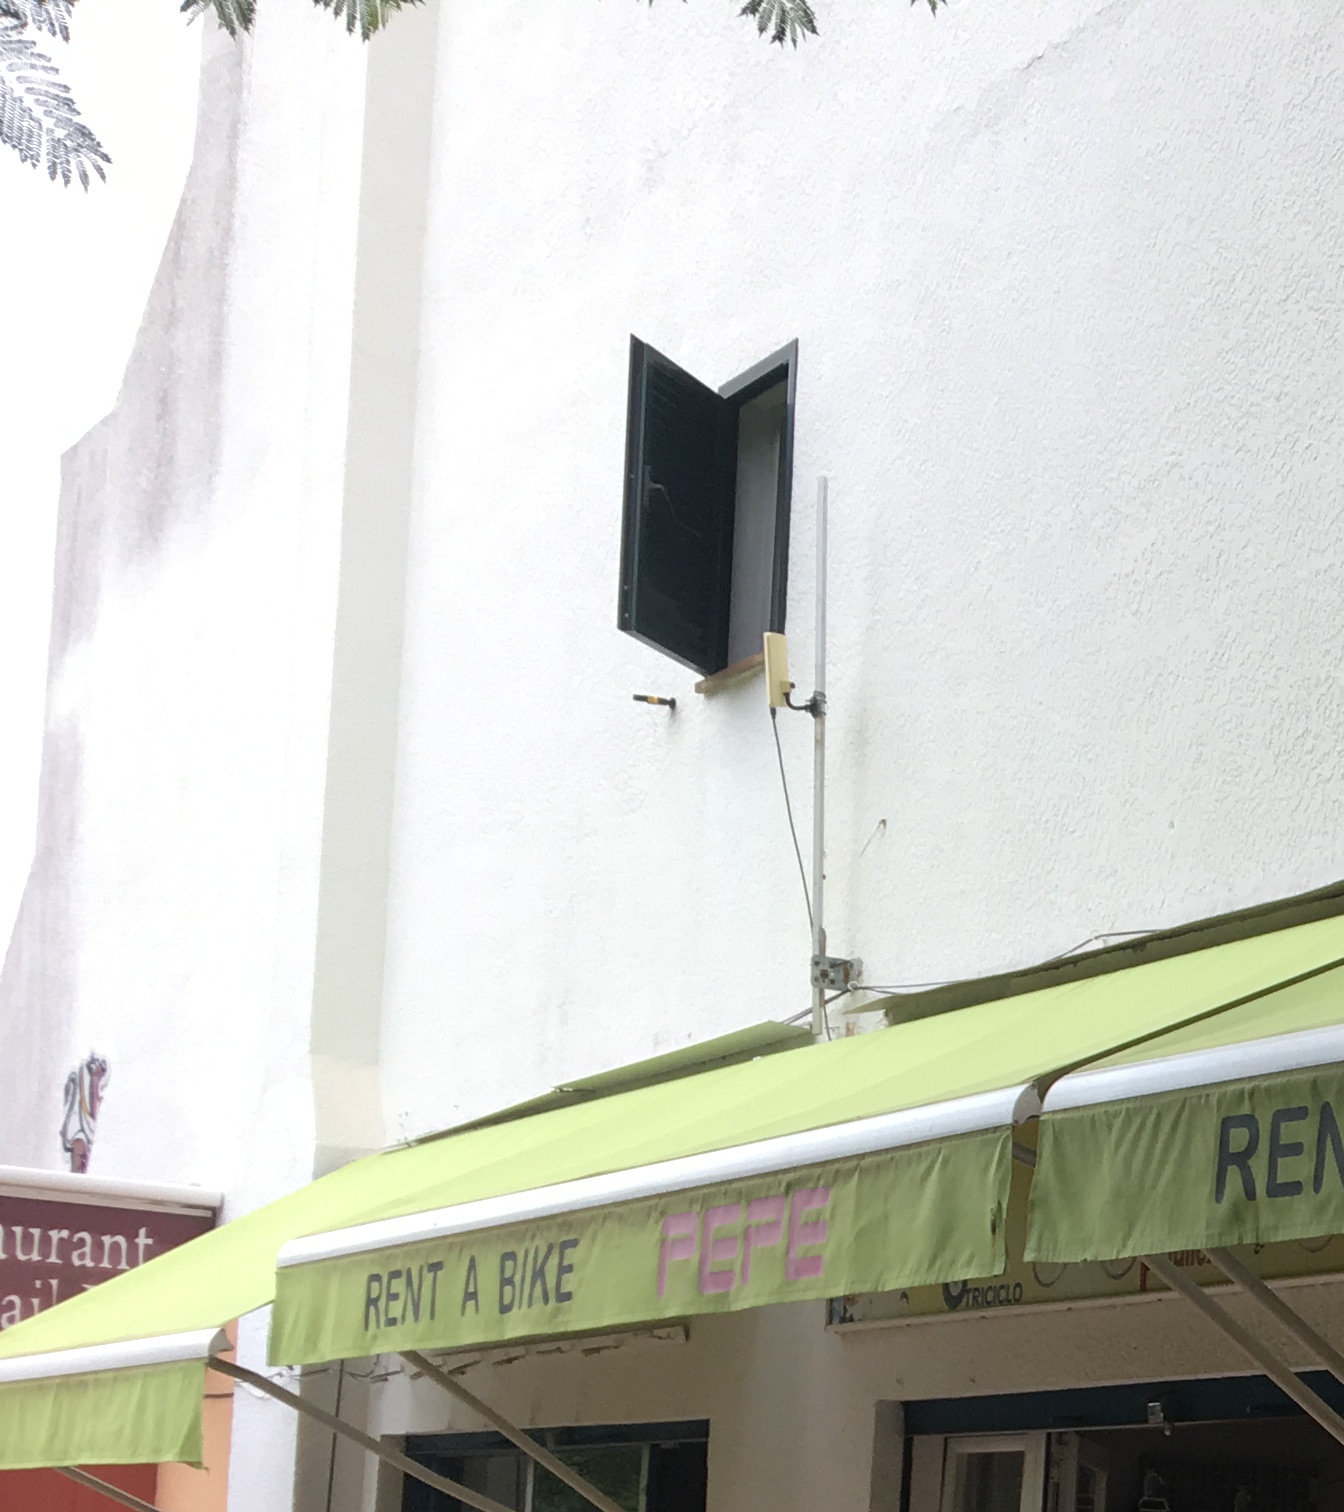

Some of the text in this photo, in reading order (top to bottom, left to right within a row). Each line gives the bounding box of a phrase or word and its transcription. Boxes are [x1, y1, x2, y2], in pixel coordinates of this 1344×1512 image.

[364, 1186, 832, 1332] RENT A BIKE PEPE
[964, 1282, 1023, 1308] TRICICLO
